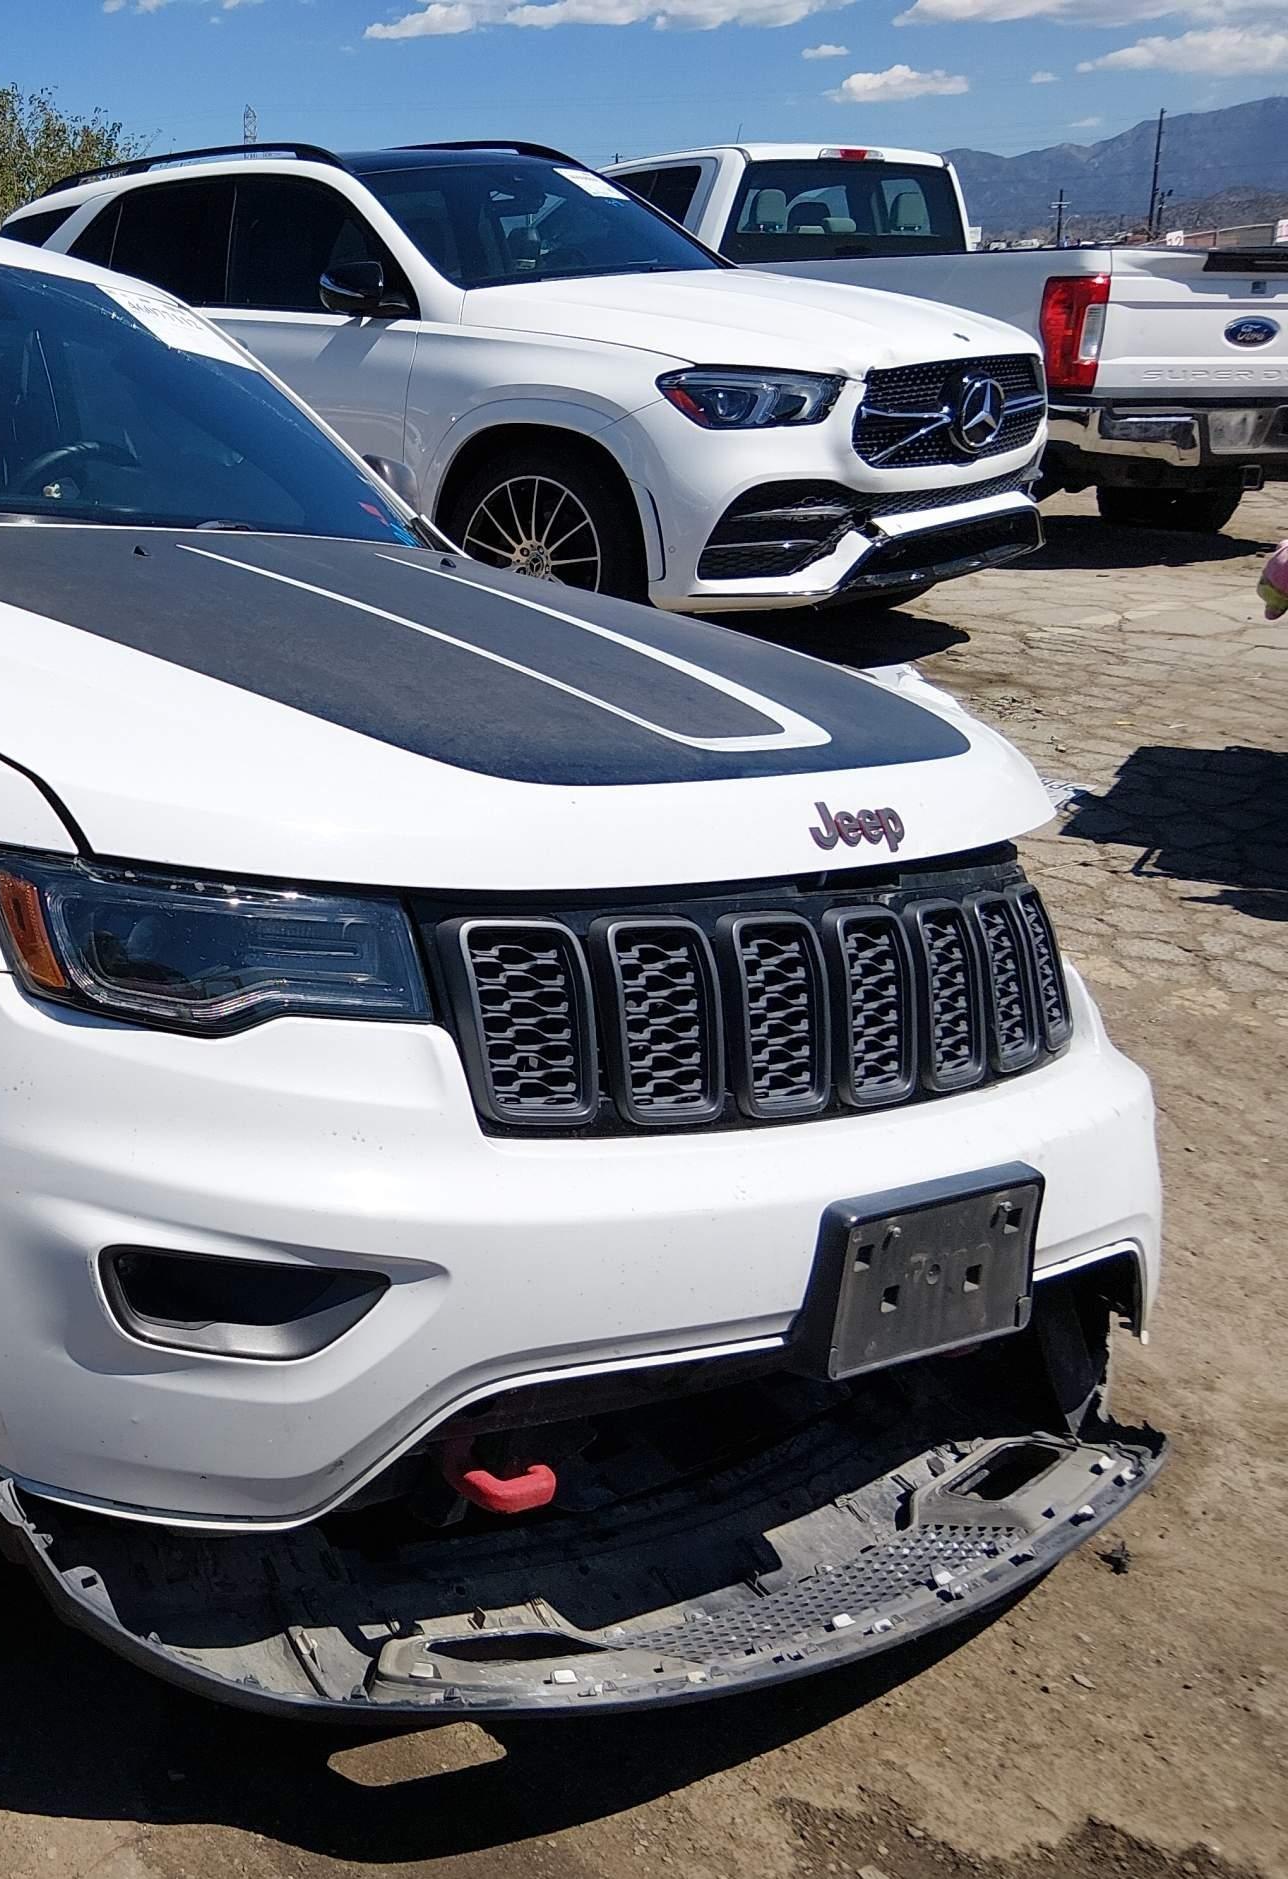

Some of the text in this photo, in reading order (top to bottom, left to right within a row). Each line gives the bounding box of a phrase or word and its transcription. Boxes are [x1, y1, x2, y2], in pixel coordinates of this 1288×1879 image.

[1141, 370, 1288, 381] SUPER D
[808, 801, 905, 853] Jeep
